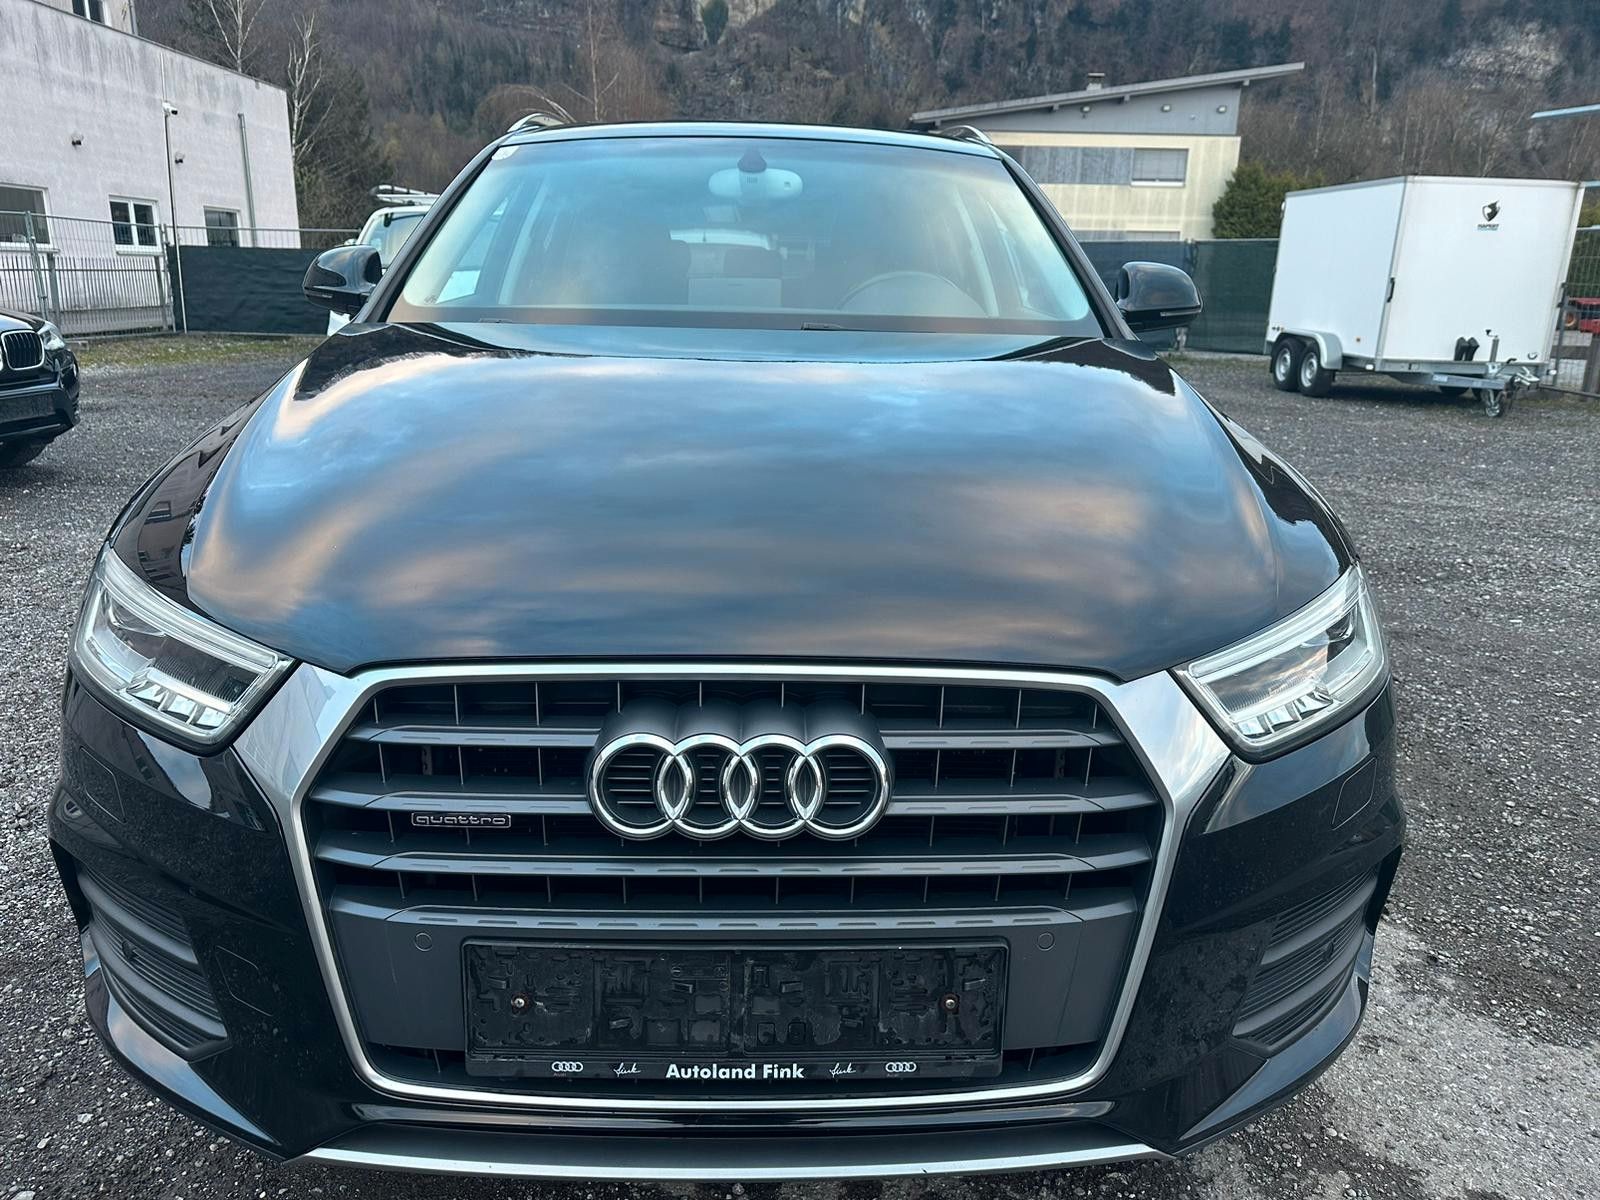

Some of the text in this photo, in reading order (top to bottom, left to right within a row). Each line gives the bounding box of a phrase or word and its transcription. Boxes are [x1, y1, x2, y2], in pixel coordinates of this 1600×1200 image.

[416, 815, 506, 825] quattro
[665, 1063, 805, 1079] Autoland Fink
